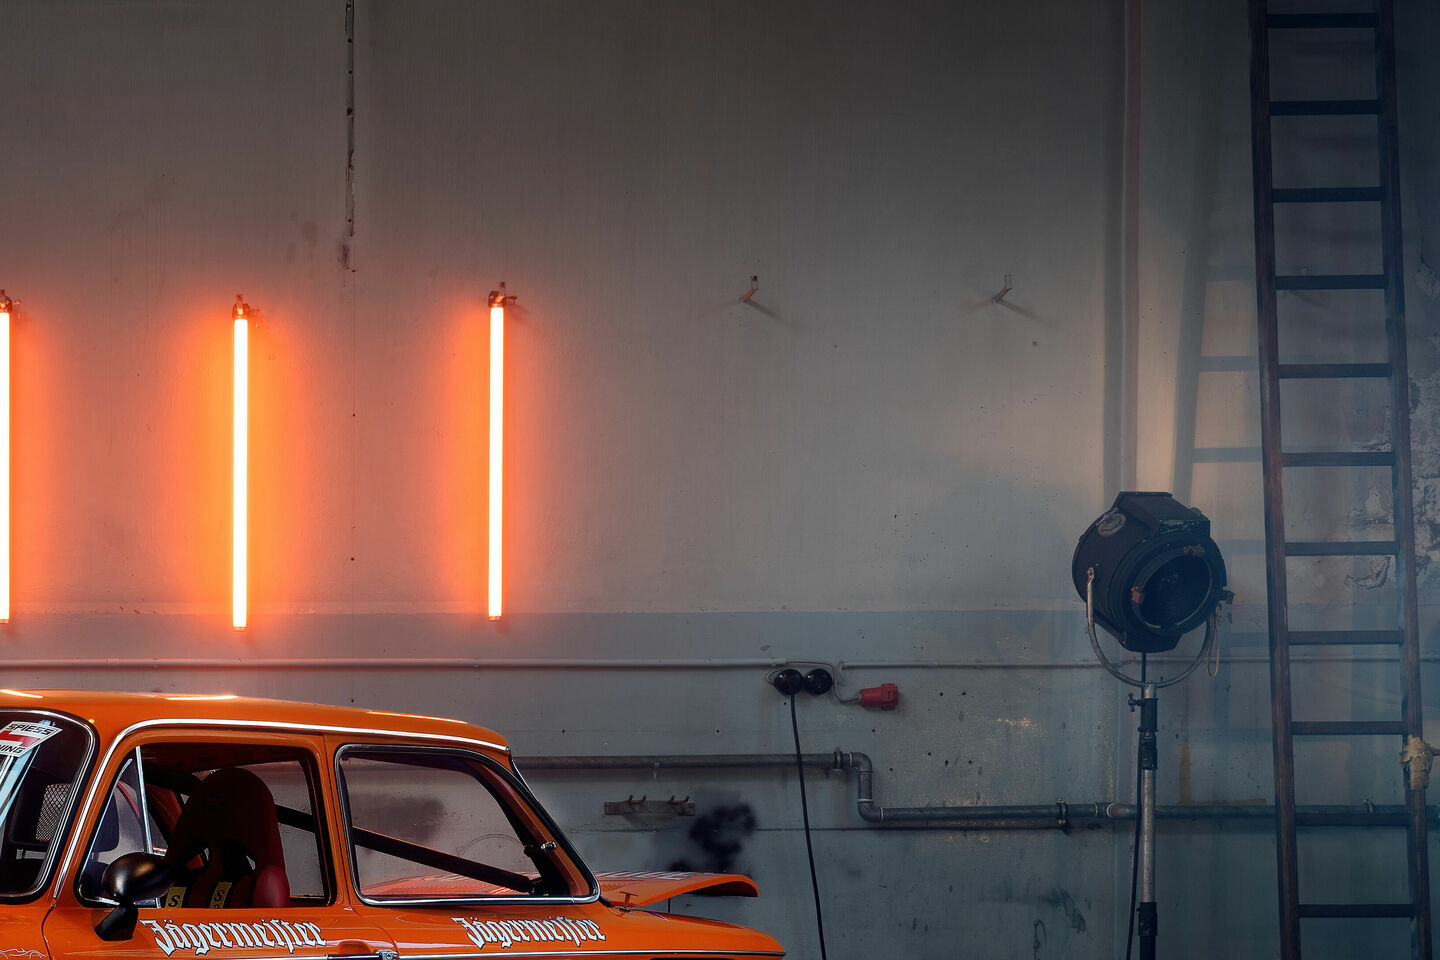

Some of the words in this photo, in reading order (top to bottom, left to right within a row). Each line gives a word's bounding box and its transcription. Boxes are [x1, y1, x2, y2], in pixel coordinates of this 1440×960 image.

[7, 723, 54, 735] SPIESS
[139, 918, 327, 956] Jägermeister
[451, 916, 606, 949] Jägermeister
